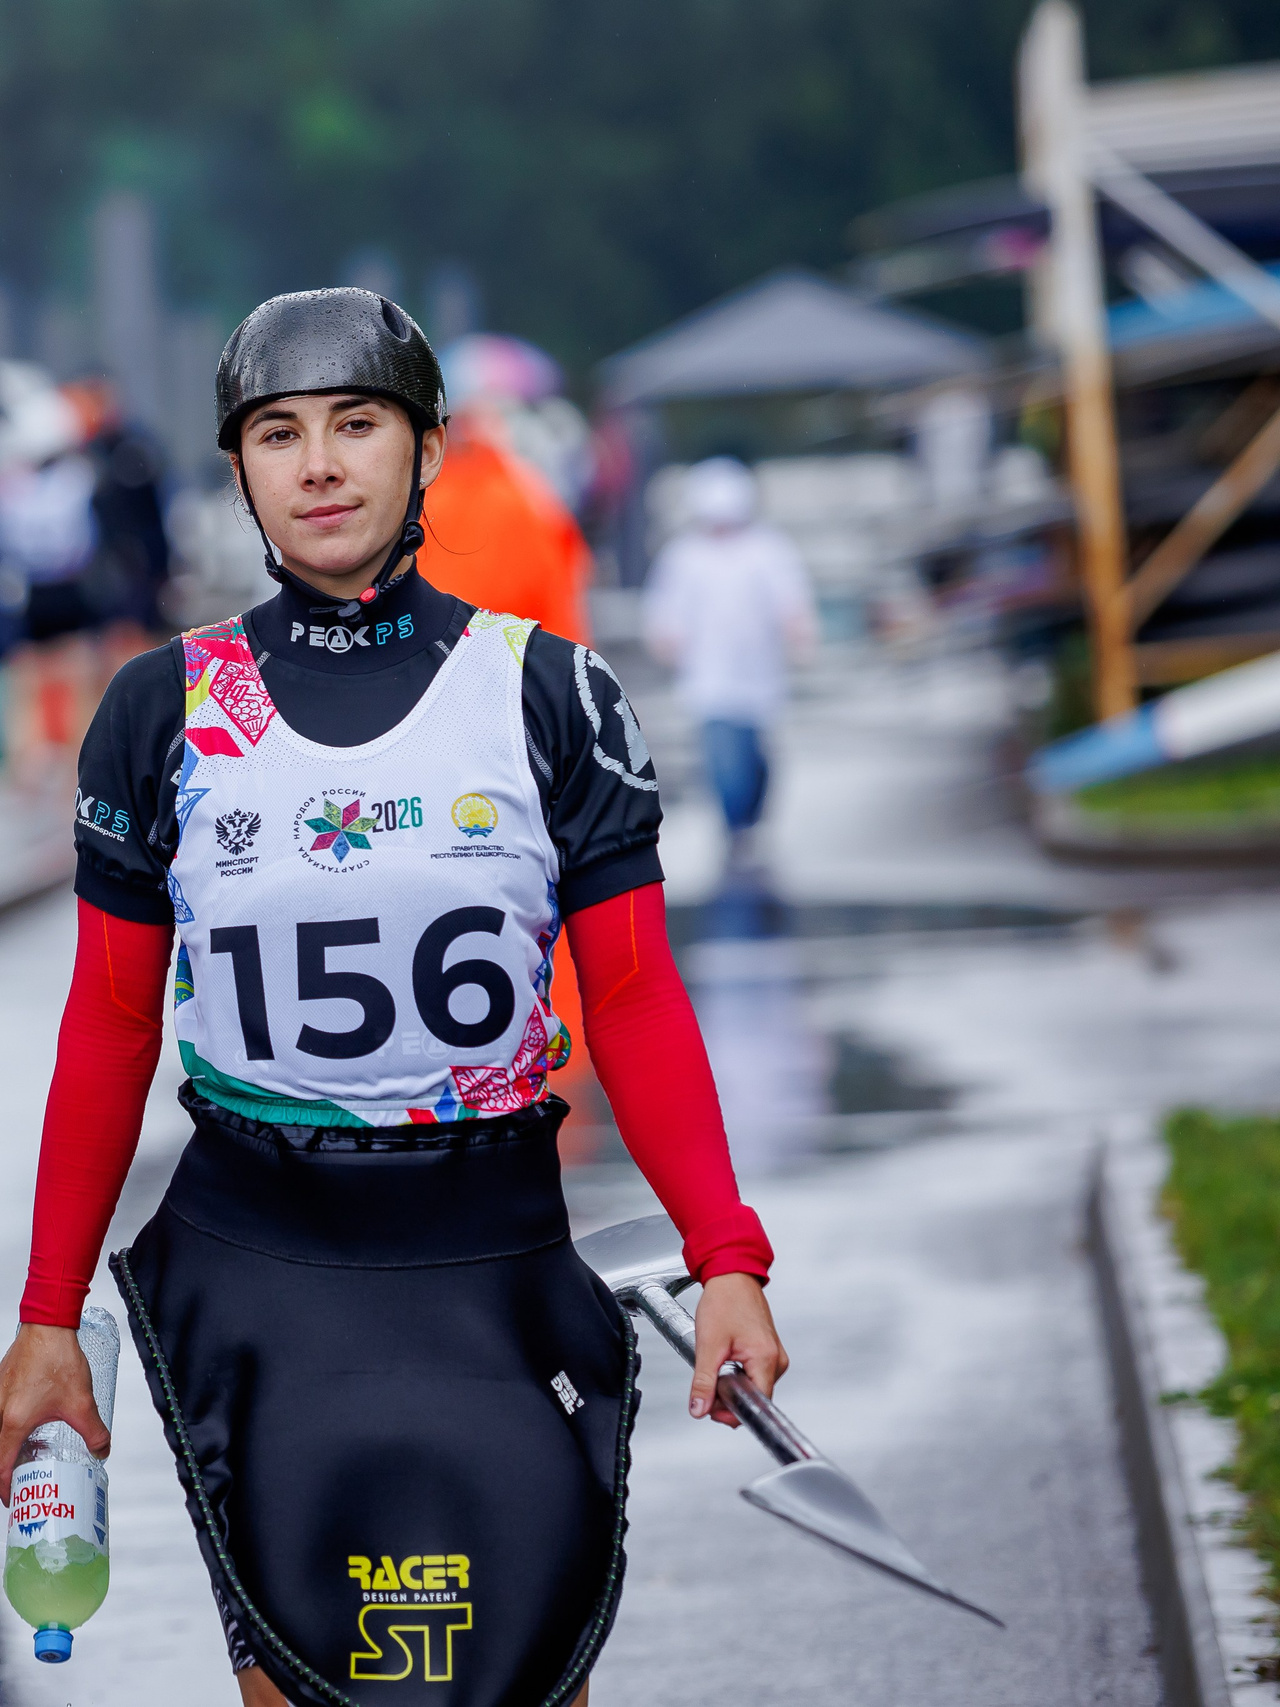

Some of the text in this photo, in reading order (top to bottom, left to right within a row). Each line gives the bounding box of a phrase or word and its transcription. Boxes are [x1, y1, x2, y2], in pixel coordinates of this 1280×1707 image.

[290, 613, 414, 653] PEAK PS
[94, 800, 130, 834] PS
[371, 796, 423, 833] 2026
[293, 788, 370, 873] СПАРТАКИАДА НАРОДОВ РОССИИ
[215, 856, 260, 869] МИНСПОРТ
[430, 851, 522, 860] РЕСПУБЛИКИ БАШКОРТОСТАН
[451, 844, 505, 852] ПРАВИТЕЛЬСТВО
[220, 866, 253, 877] РОССИИ
[210, 905, 516, 1062] 156
[16, 1469, 53, 1485] РОДНИК
[13, 1483, 59, 1507] КЛЮЧ
[348, 1554, 470, 1590] RACER
[362, 1591, 458, 1603] DESIGN PATENT
[350, 1602, 473, 1682] ST
